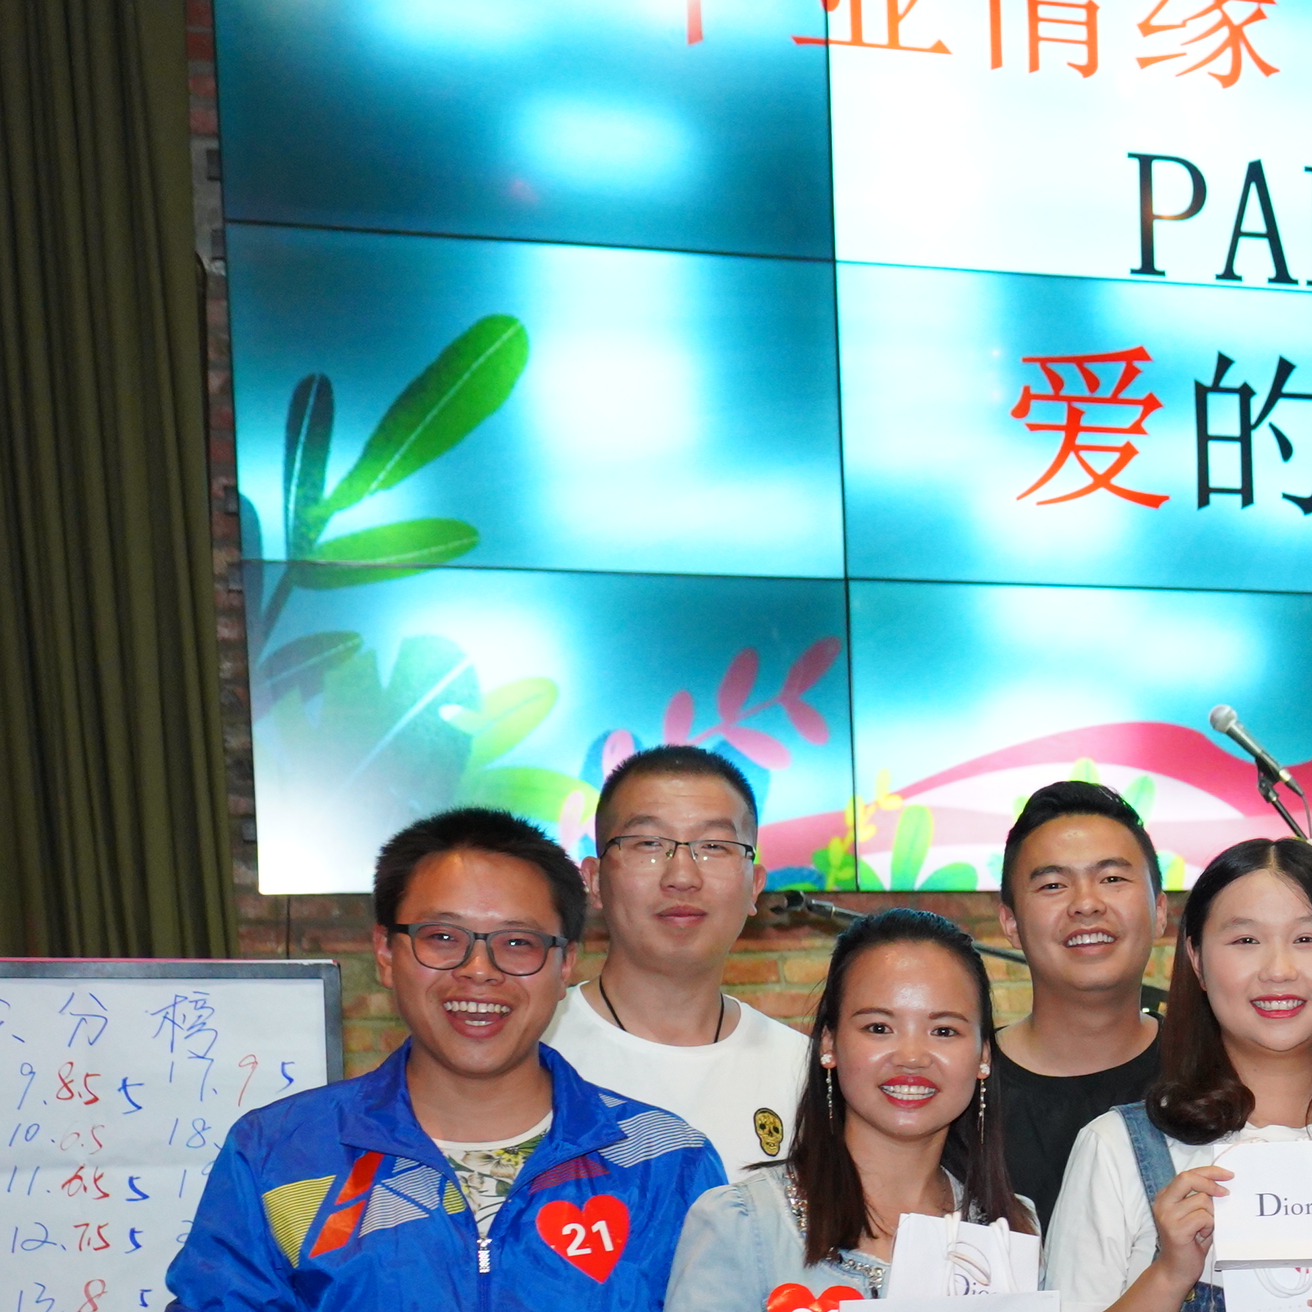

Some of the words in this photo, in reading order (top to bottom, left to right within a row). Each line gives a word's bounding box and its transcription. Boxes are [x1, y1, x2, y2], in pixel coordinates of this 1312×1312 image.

[56, 1061, 101, 1105] 8.5
[118, 1077, 144, 1114] 5
[238, 1054, 258, 1107] 9
[276, 1061, 295, 1094] 5
[126, 1176, 149, 1201] 5
[127, 1227, 143, 1253] 5
[561, 1220, 614, 1257] 21
[140, 1289, 153, 1307] 5
